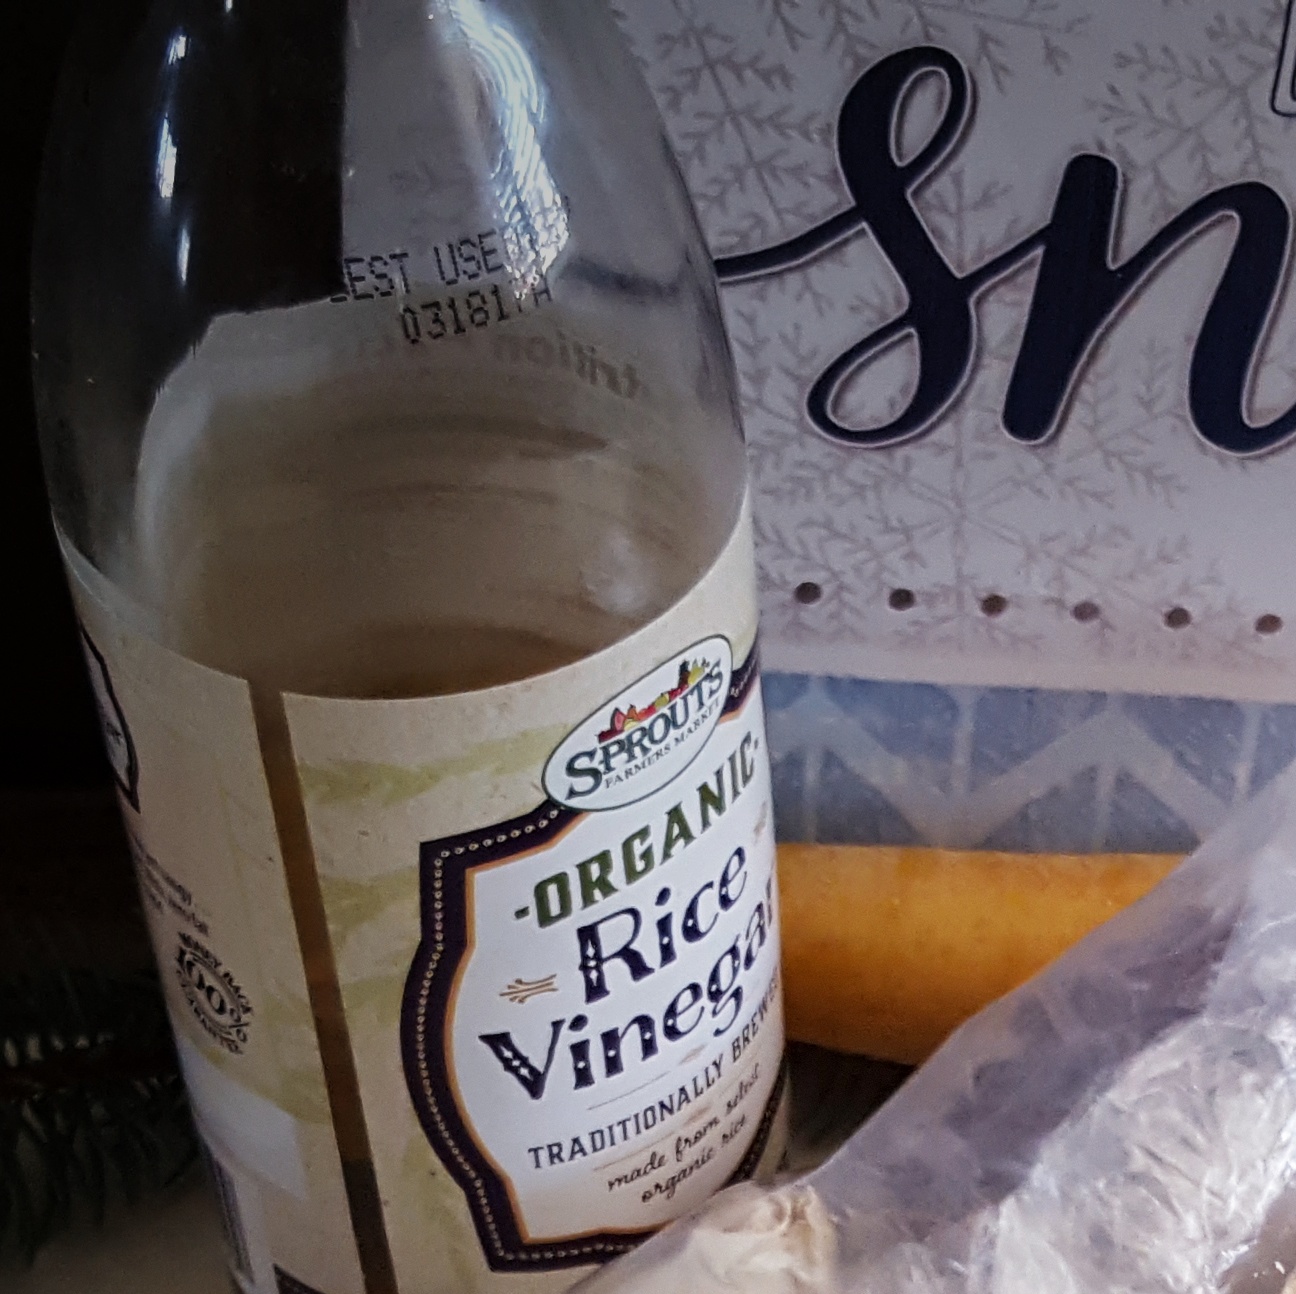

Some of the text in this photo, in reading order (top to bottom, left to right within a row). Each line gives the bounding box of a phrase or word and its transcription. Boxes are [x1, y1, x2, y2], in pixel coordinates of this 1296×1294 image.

[330, 251, 411, 304] EST
[564, 656, 724, 801] SPROUTS
[603, 697, 722, 790] FARMERS MARKET
[576, 846, 748, 1005] Rice
[527, 965, 778, 1169] TRADITIONALLY BREWE
[607, 1151, 667, 1192] made
[674, 1116, 720, 1163] from
[640, 1147, 717, 1203] organic
